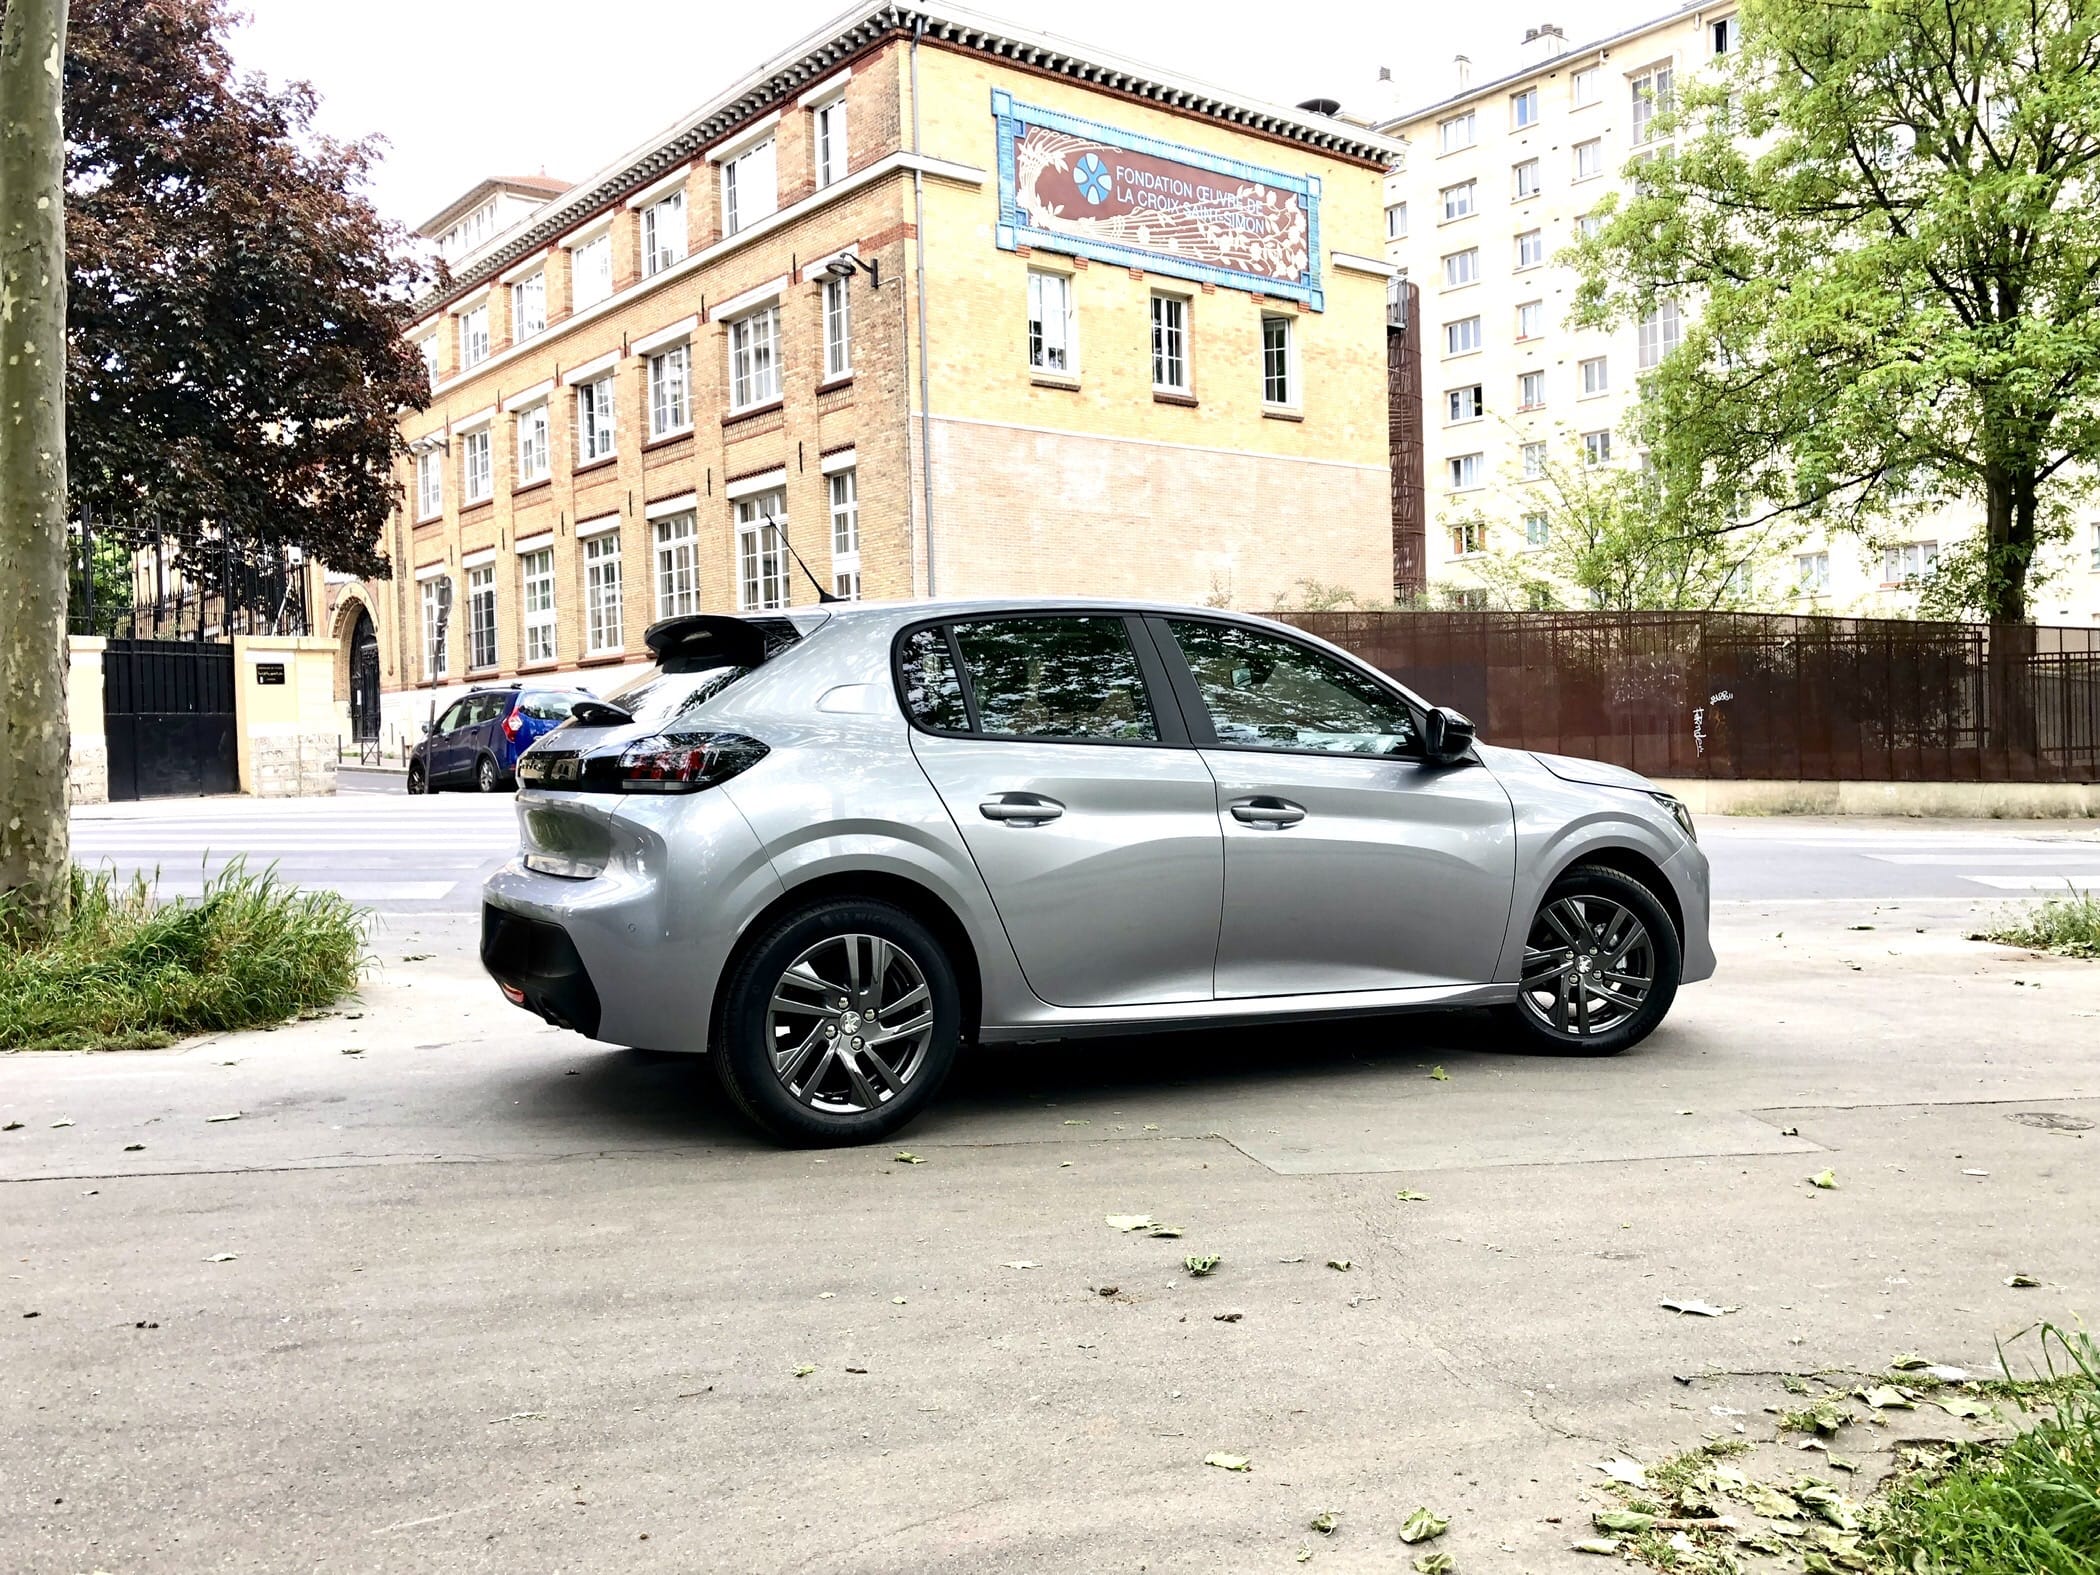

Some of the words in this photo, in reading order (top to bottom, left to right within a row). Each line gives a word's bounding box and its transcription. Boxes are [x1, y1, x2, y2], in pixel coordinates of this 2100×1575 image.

[1116, 165, 1193, 199] FONDATION
[1247, 197, 1264, 215] DE
[1117, 185, 1135, 205] LA
[1137, 190, 1179, 215] CROIX
